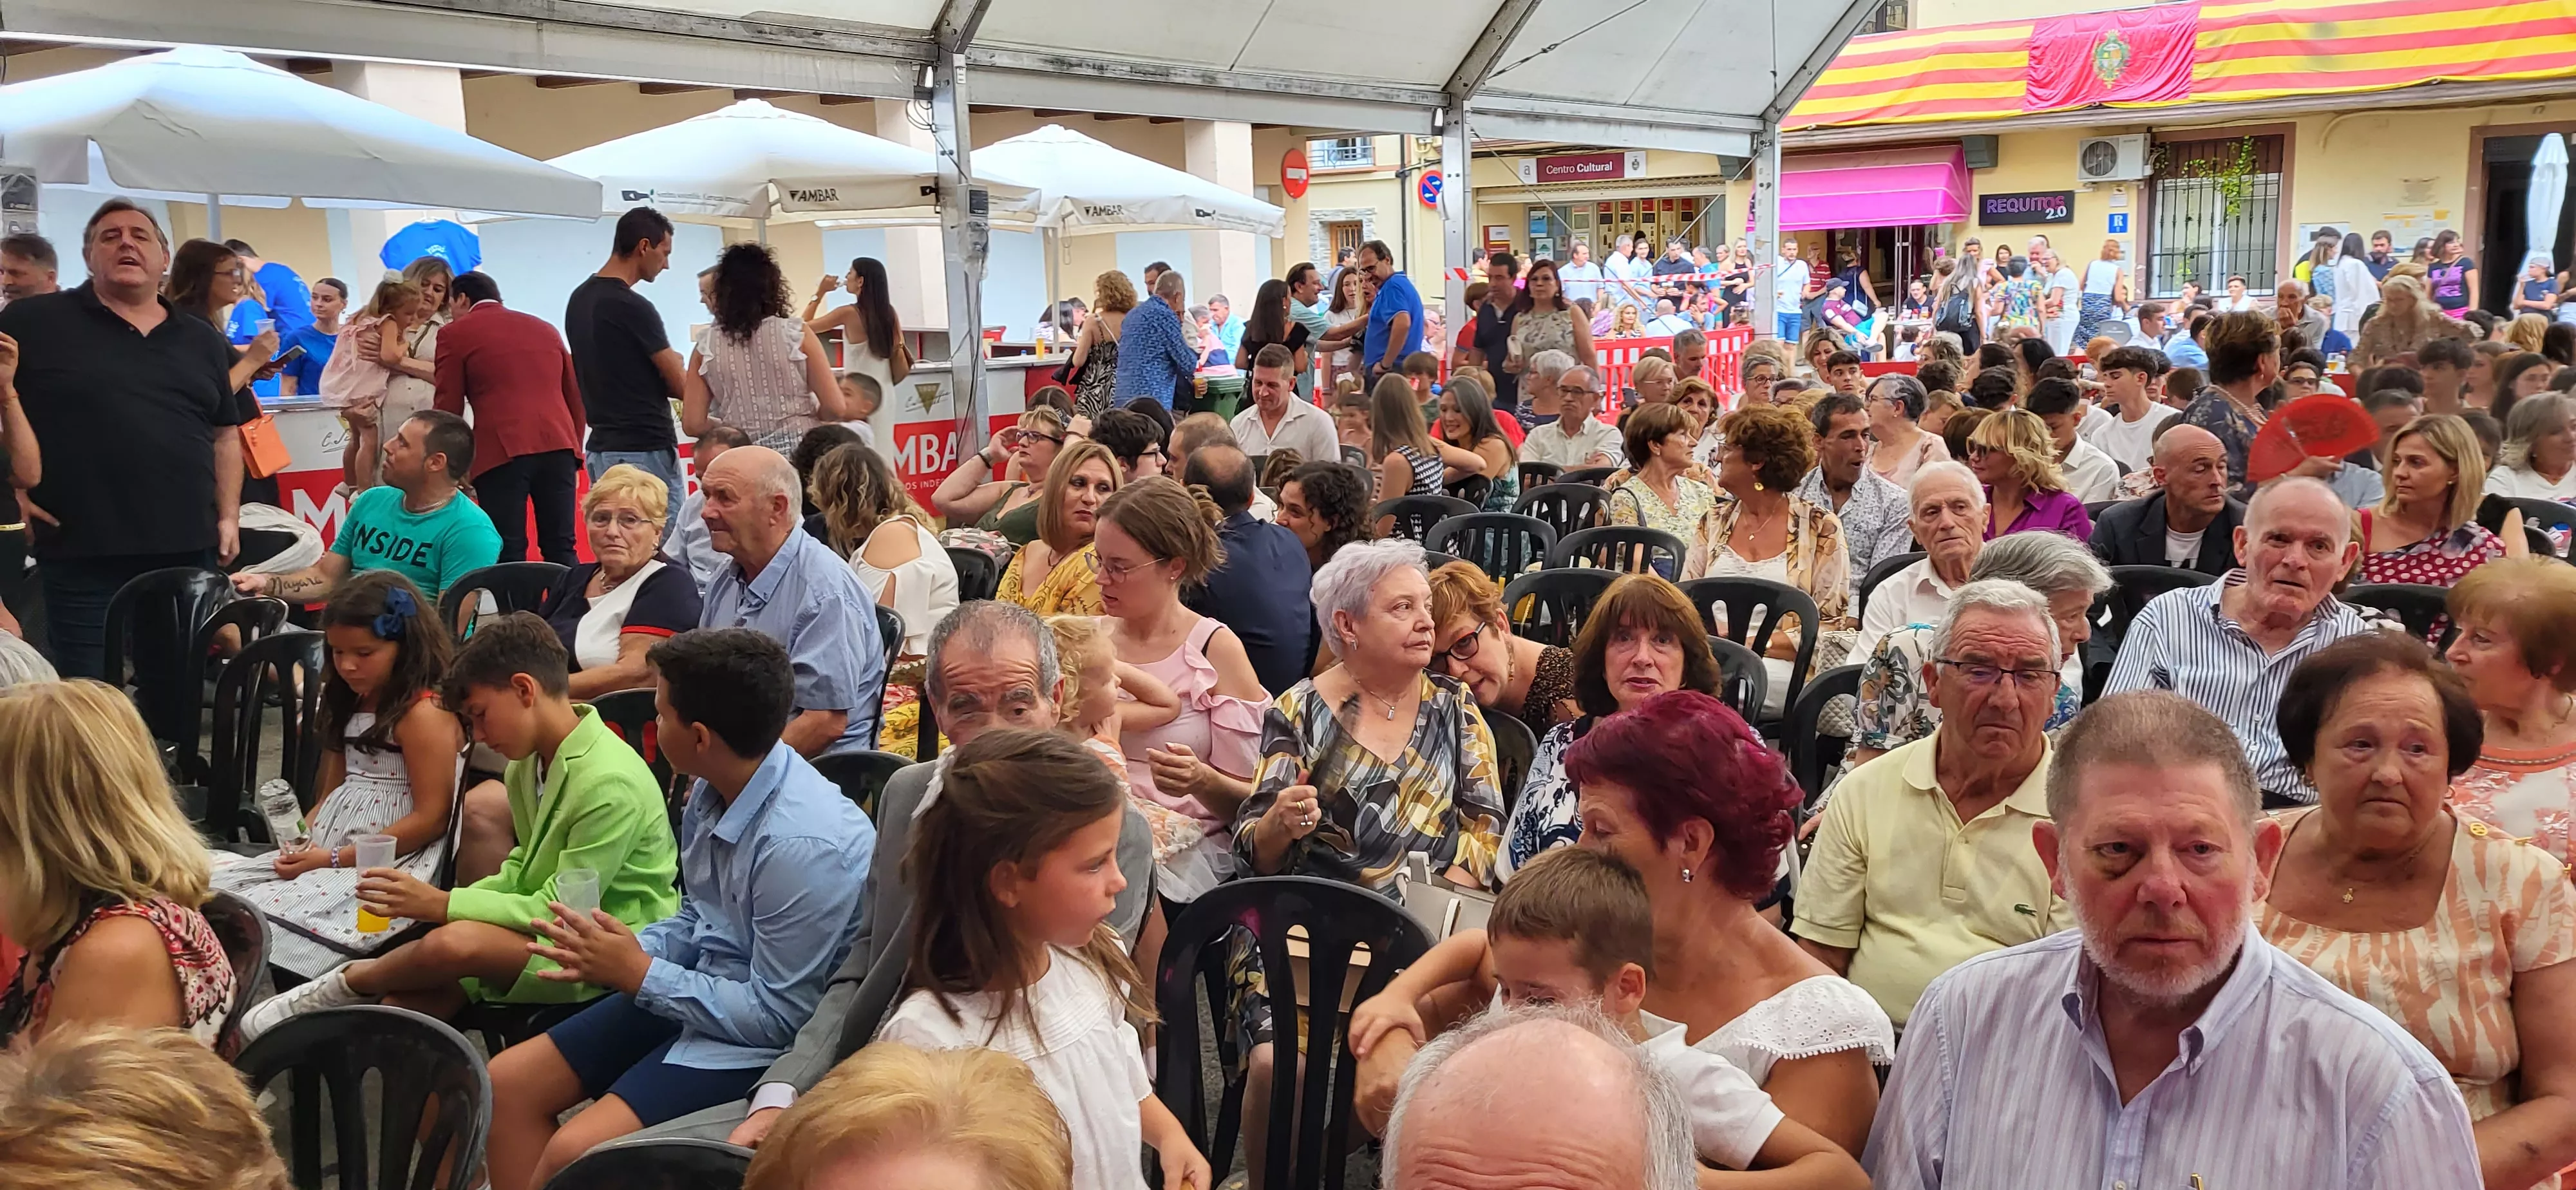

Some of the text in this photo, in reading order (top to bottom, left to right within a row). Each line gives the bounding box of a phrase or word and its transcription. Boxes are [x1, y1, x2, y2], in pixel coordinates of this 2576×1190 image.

[1546, 161, 1613, 175] Centro Cultural
[797, 189, 839, 202] AMBAR
[1092, 205, 1124, 216] AMBAR
[2045, 206, 2067, 220] 2.0
[894, 431, 958, 475] MBA
[354, 521, 433, 568] INSIDE
